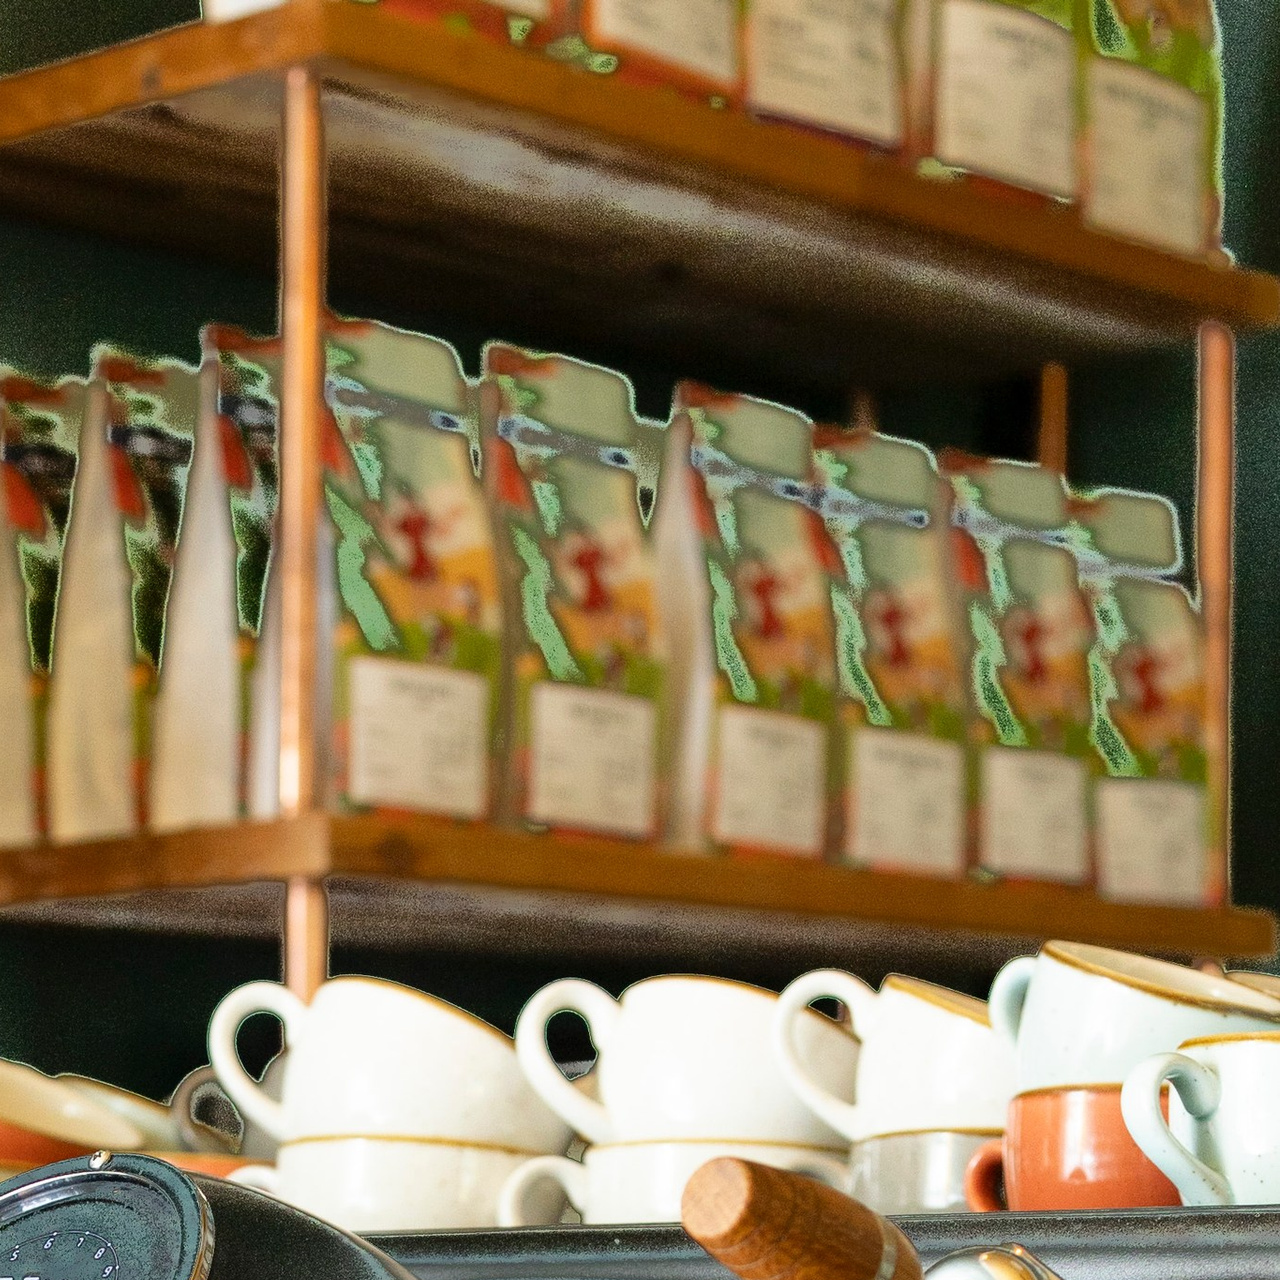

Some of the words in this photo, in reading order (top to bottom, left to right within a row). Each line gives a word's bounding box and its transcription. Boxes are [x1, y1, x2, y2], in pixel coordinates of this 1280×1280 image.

[43, 1237, 55, 1250] 6
[76, 1237, 85, 1247] 7
[9, 1249, 20, 1261] 5
[93, 1247, 106, 1259] 8
[101, 1265, 113, 1277] 9
